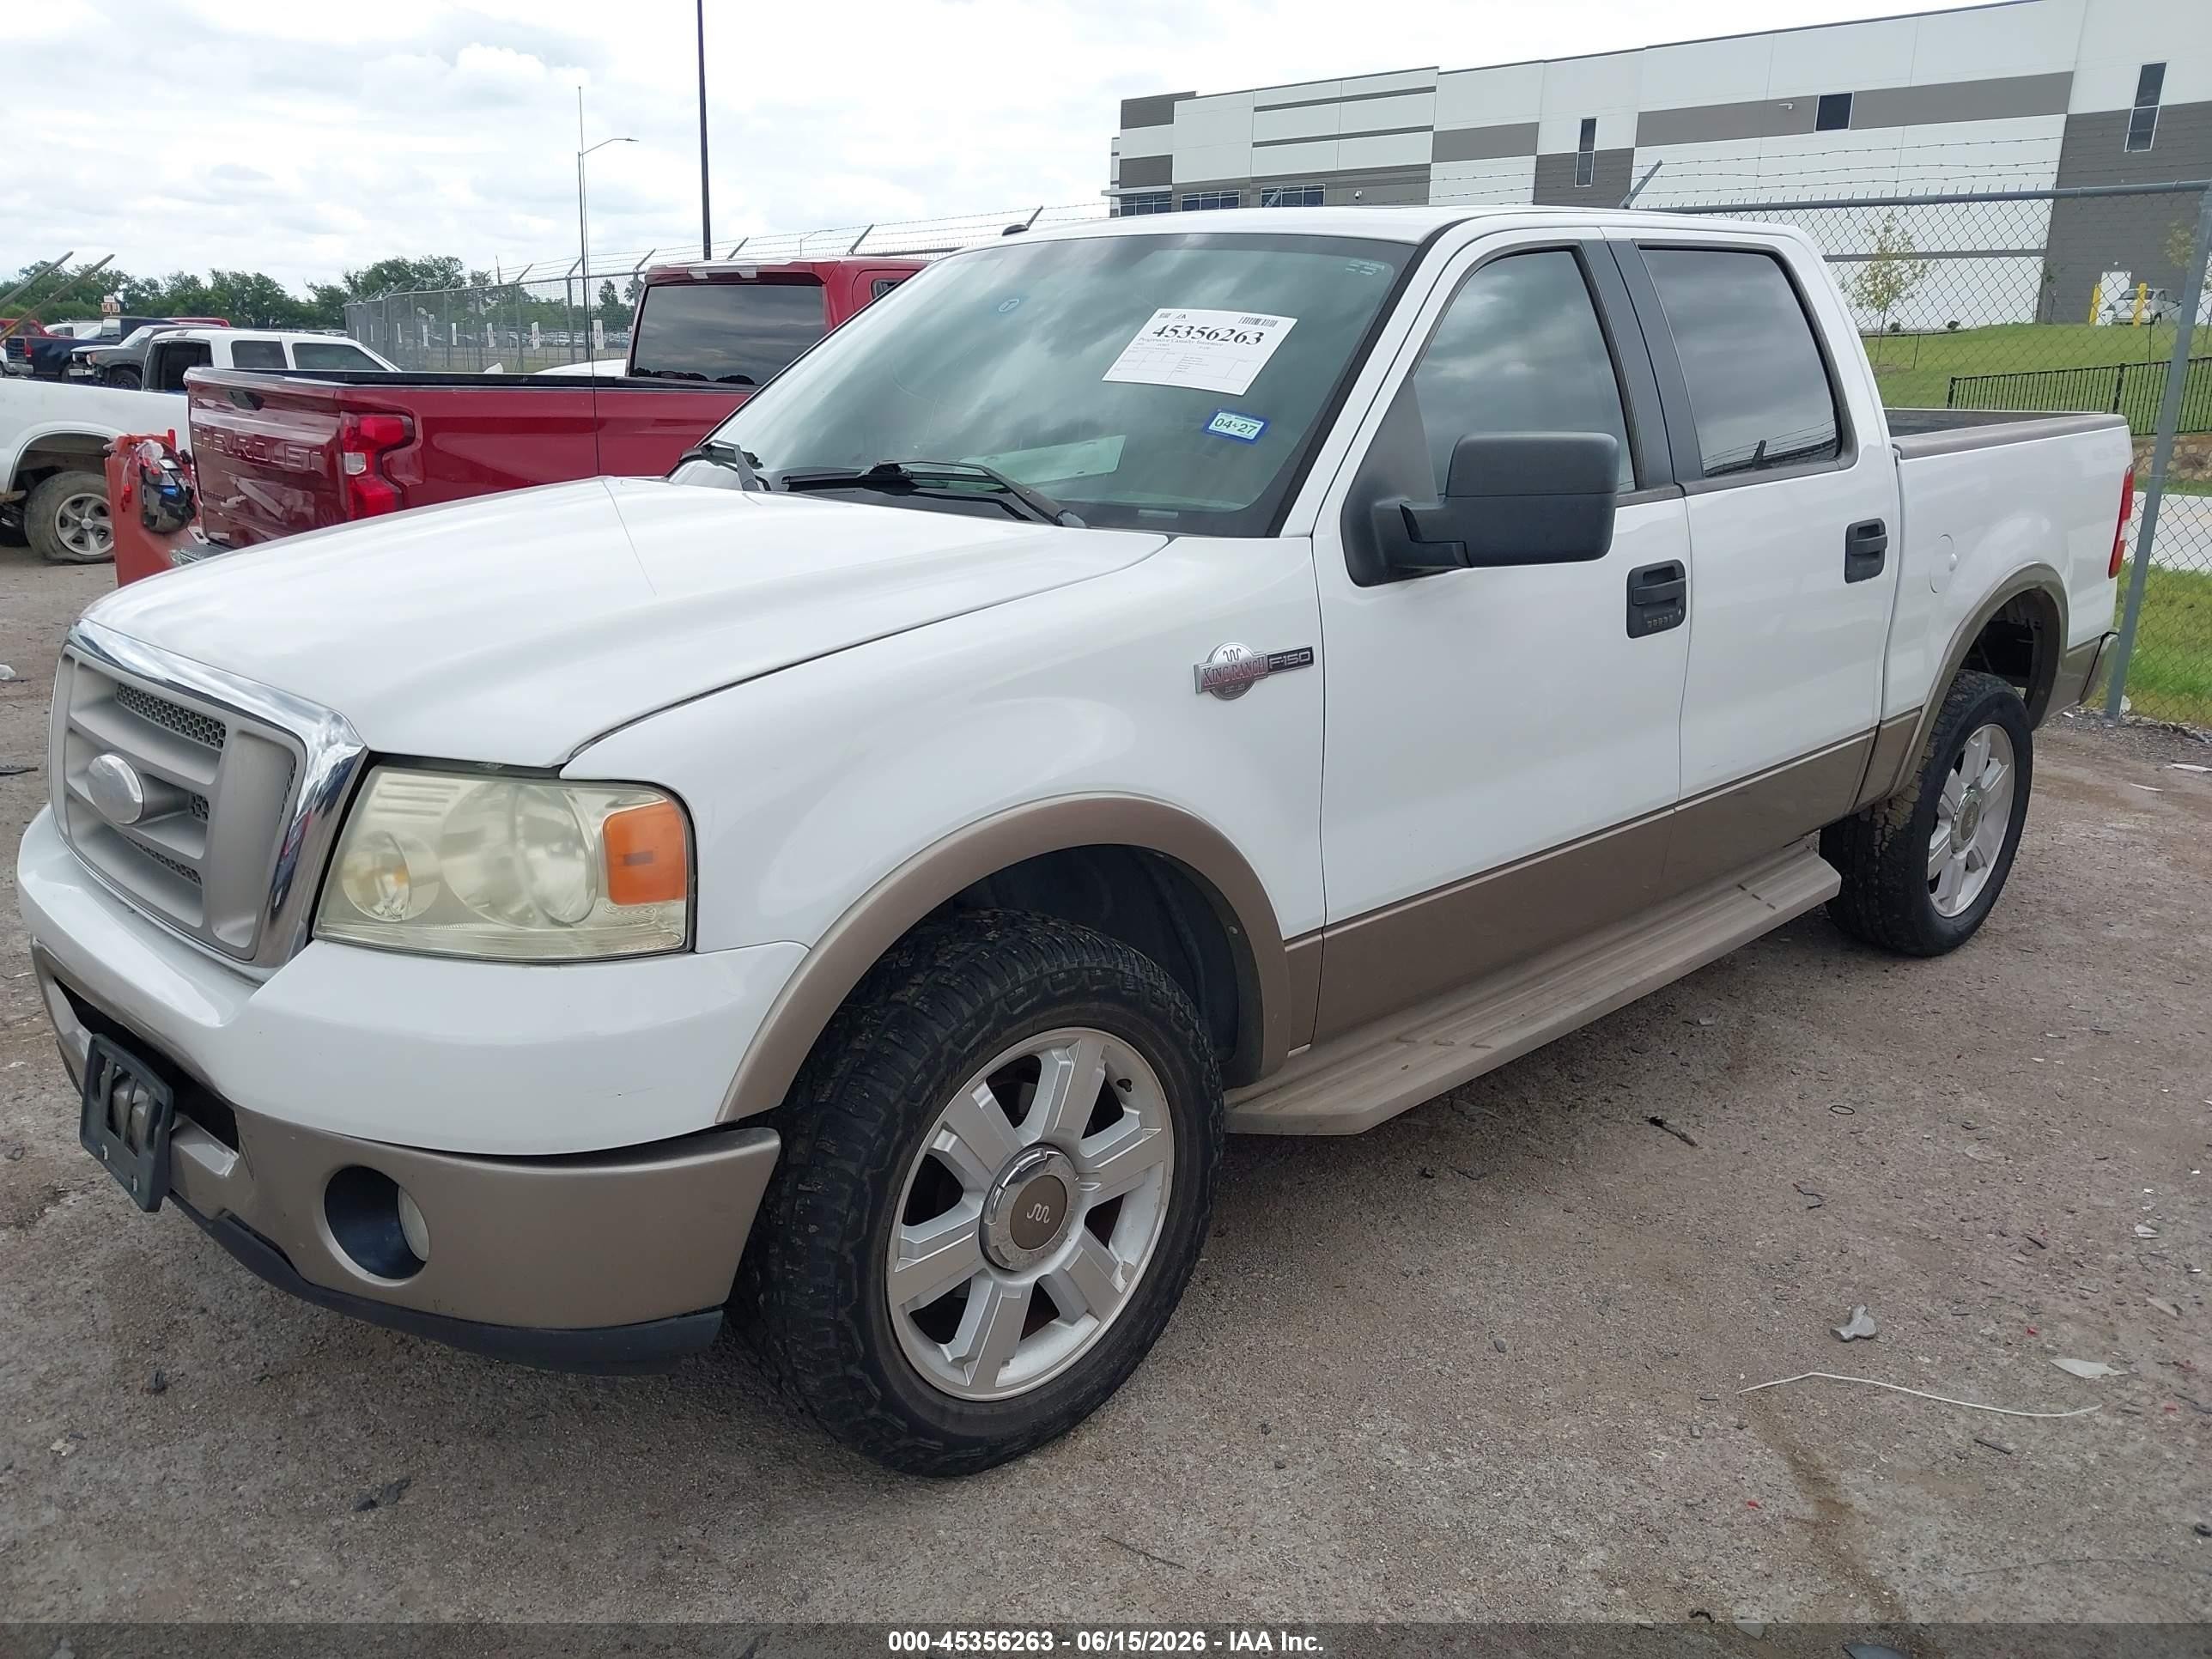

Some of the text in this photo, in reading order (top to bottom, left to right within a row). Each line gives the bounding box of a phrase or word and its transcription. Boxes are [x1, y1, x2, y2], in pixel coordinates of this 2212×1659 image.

[1152, 324, 1265, 346] 45356263
[192, 427, 322, 471] CHEVROLET
[1202, 658, 1267, 687] KING RANCH
